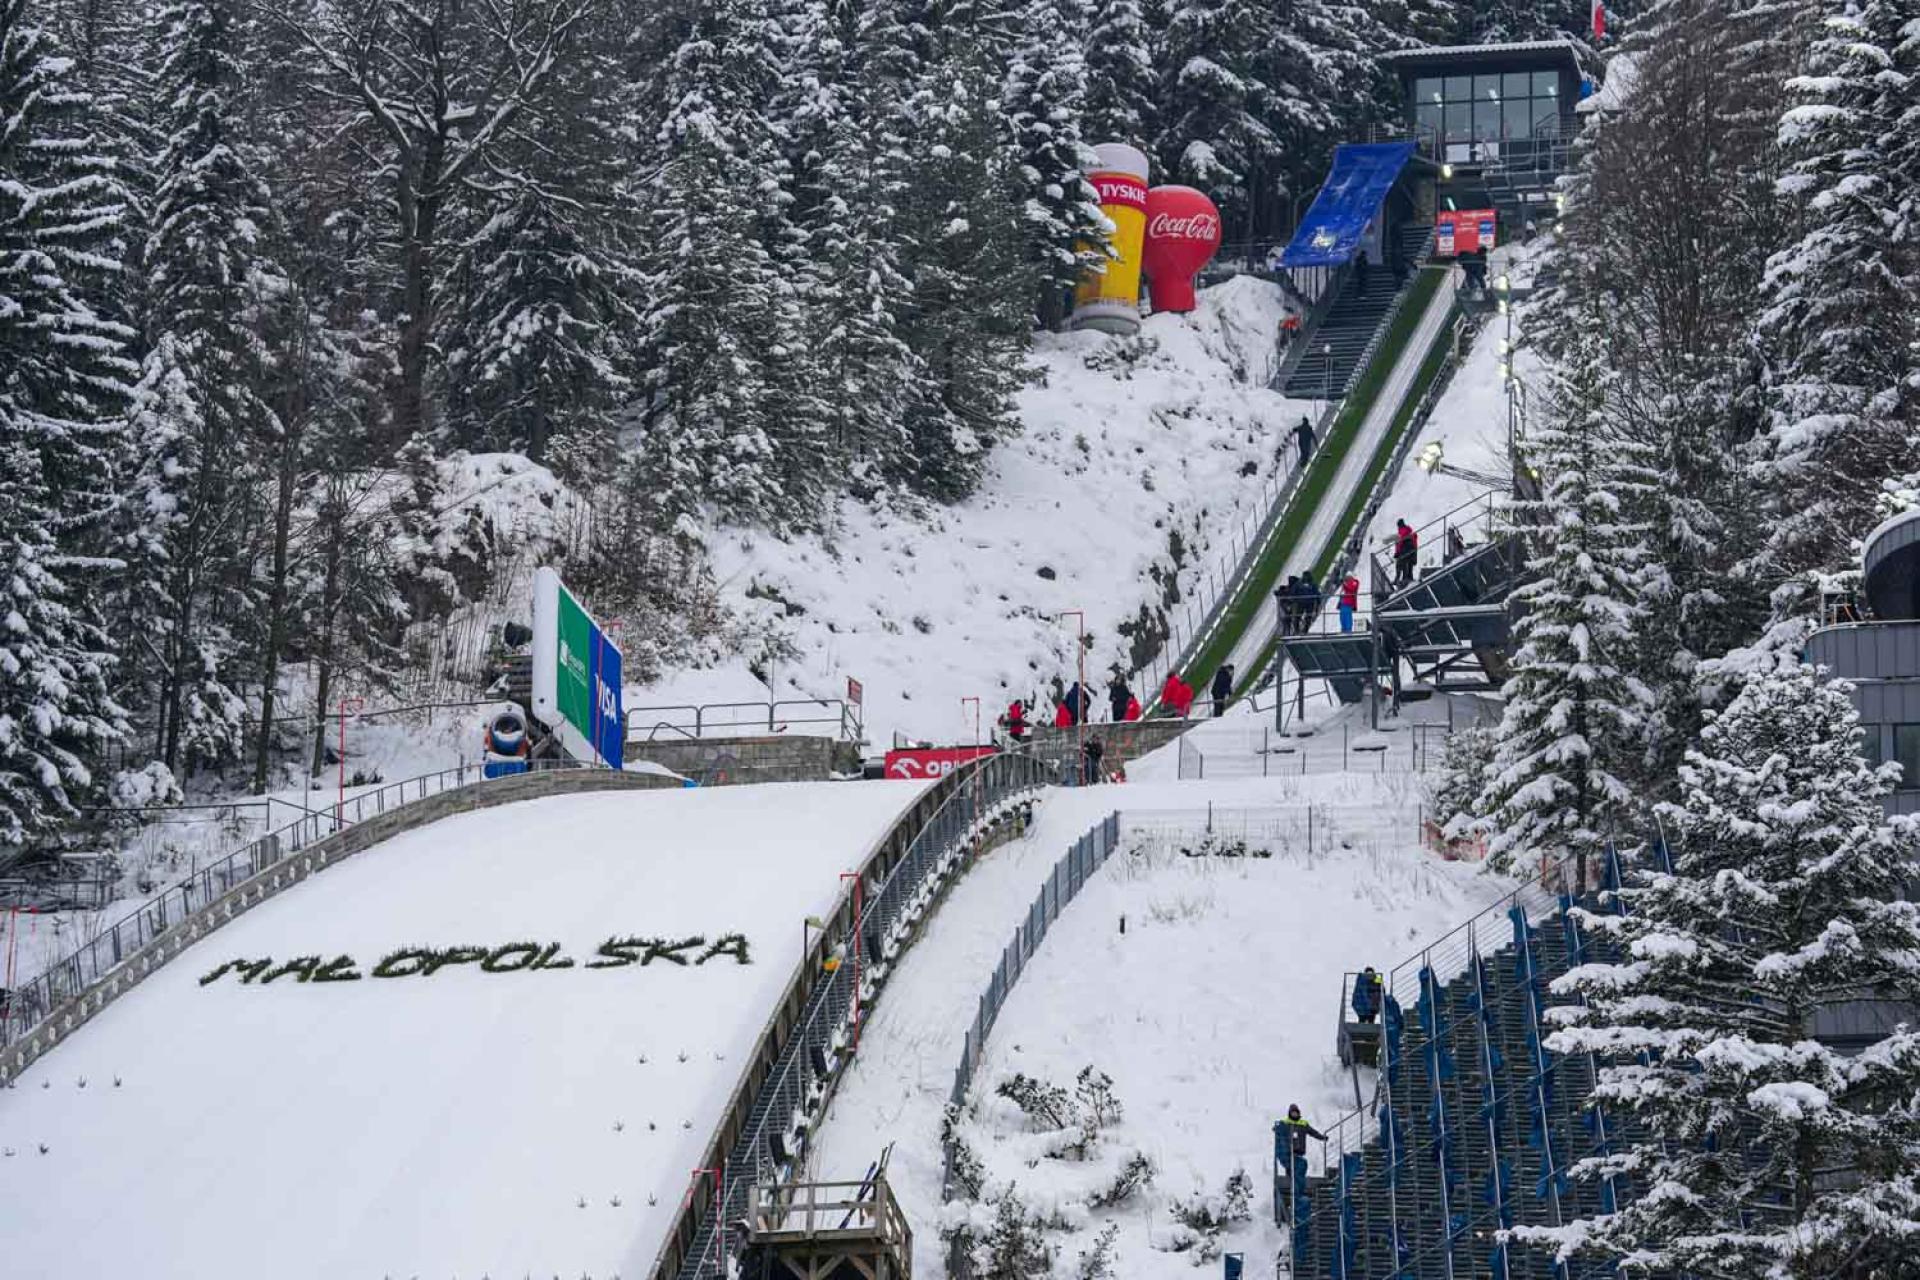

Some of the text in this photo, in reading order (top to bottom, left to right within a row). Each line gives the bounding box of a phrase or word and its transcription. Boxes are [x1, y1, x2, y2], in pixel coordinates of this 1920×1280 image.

[1101, 184, 1146, 204] TYSKIE
[1150, 213, 1217, 240] Coca-Cola
[595, 672, 617, 724] VISA
